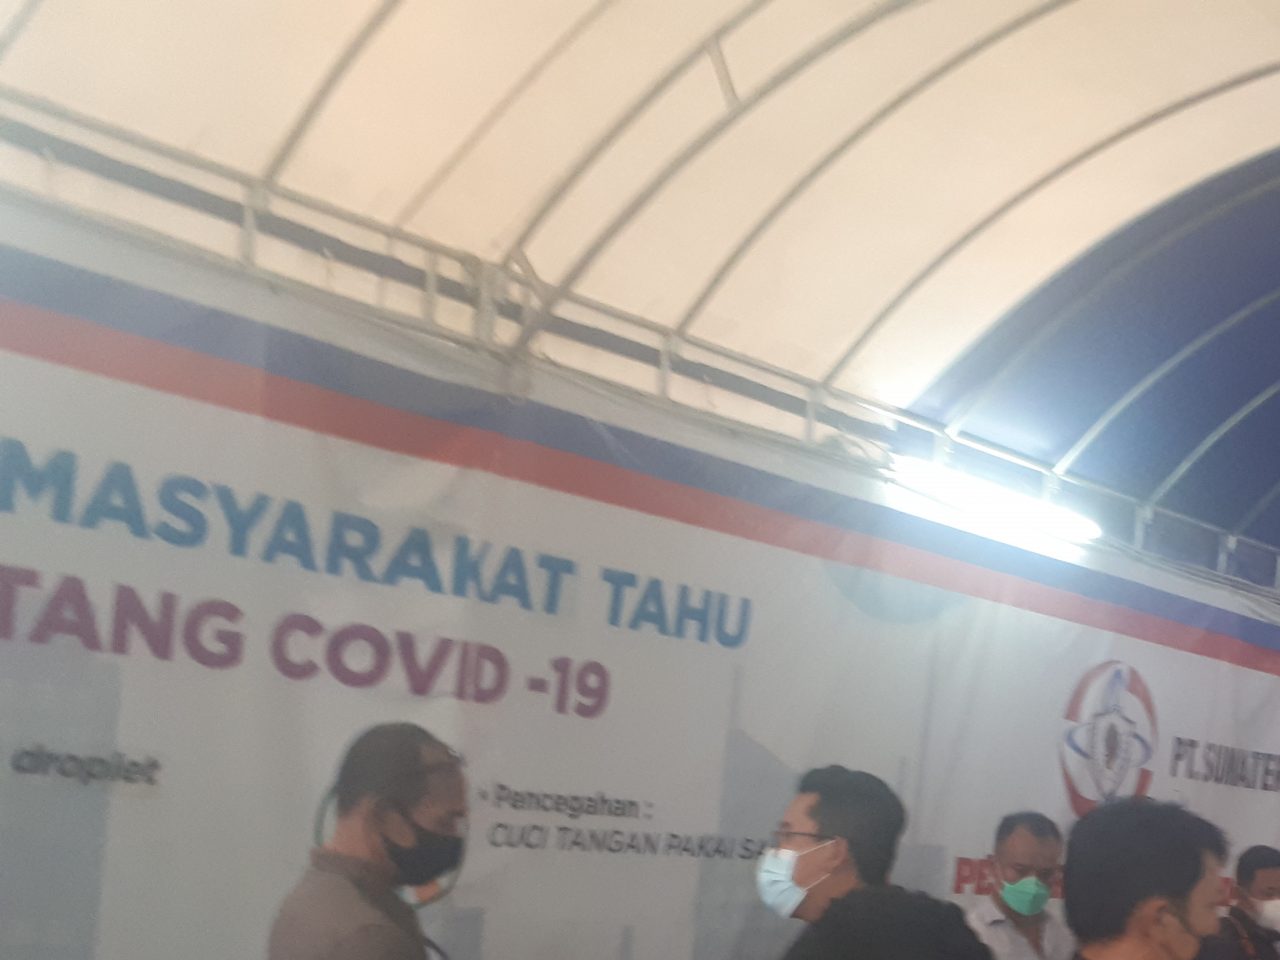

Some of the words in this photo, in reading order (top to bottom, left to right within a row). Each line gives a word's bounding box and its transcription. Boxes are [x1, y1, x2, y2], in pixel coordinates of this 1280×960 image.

[0, 436, 577, 617] MASYARAKAT
[600, 567, 753, 650] TAHU
[0, 563, 246, 670] TANG
[269, 612, 511, 704] COVID
[525, 656, 612, 719] -19
[11, 743, 162, 785] droplet
[487, 822, 547, 850] CUCI
[557, 826, 661, 857] TANGAN
[664, 832, 736, 858] PAKAI
